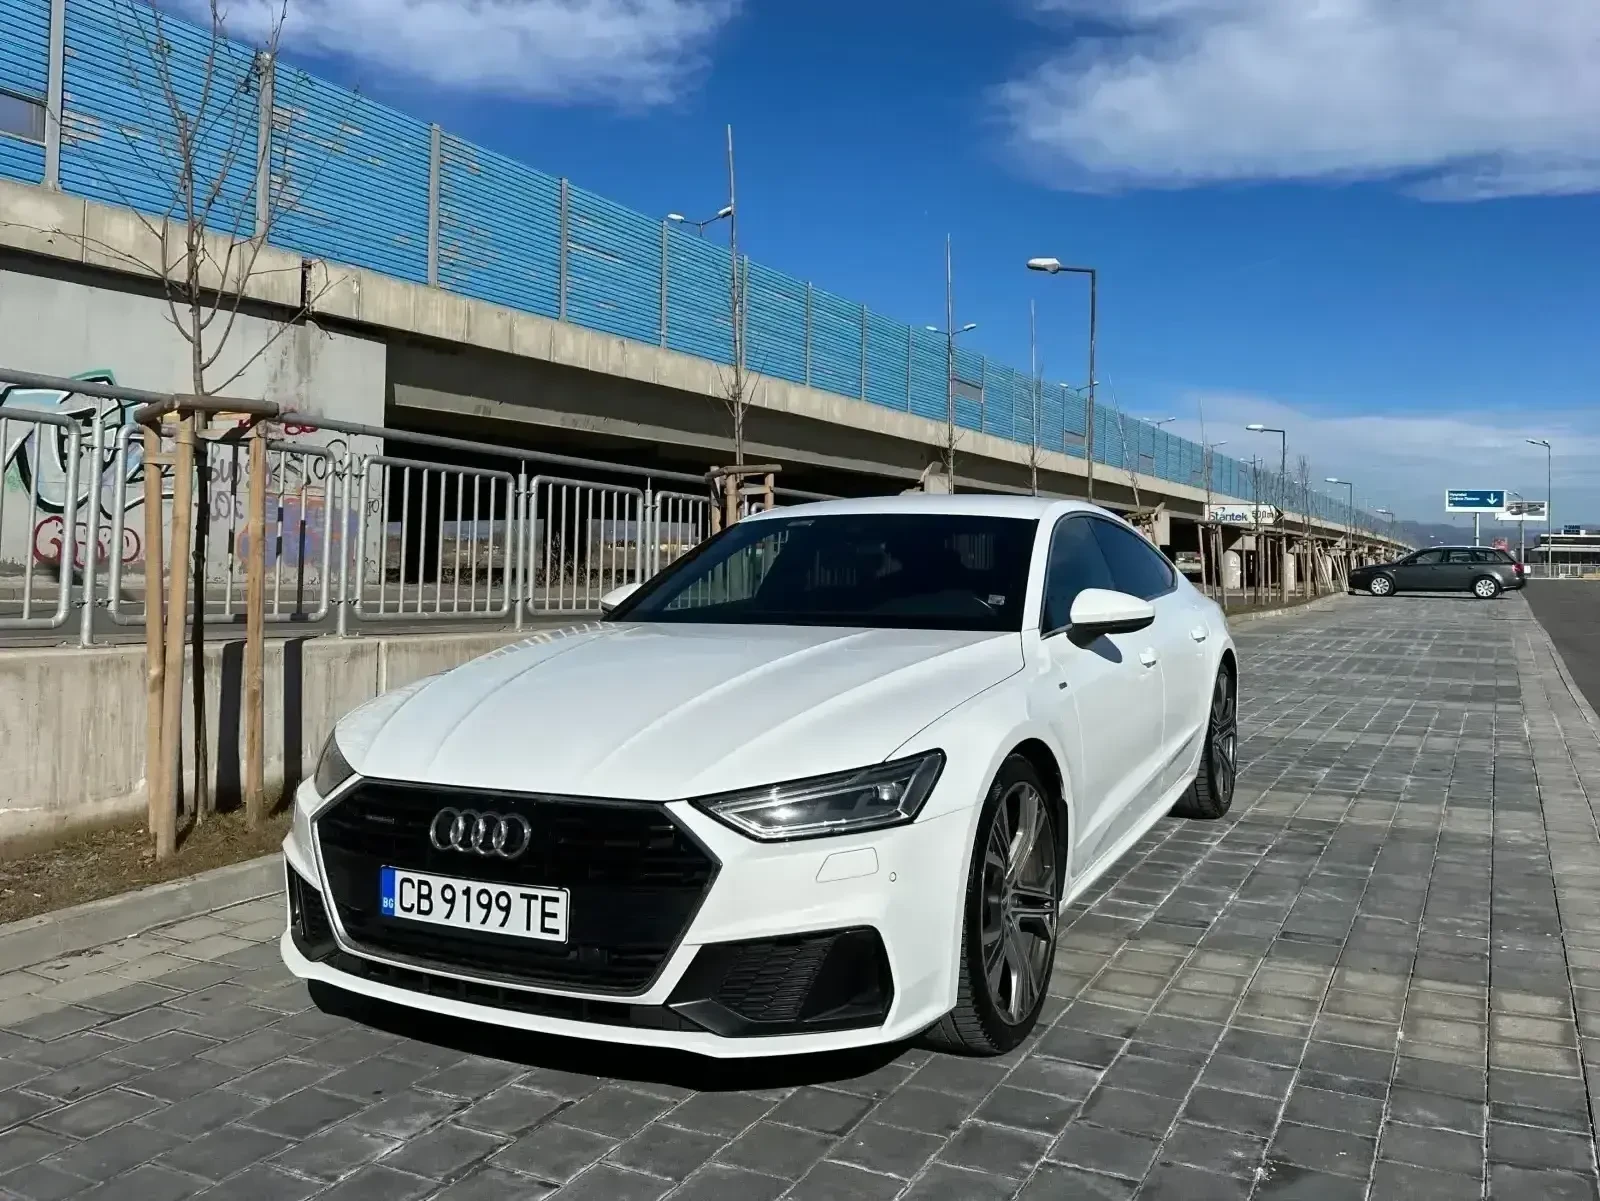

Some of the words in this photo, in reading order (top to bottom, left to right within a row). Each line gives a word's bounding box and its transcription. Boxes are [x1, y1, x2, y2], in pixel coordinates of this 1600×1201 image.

[383, 897, 394, 908] BG
[399, 877, 434, 916] CB
[440, 883, 512, 928] 9199
[519, 892, 560, 935] TE
